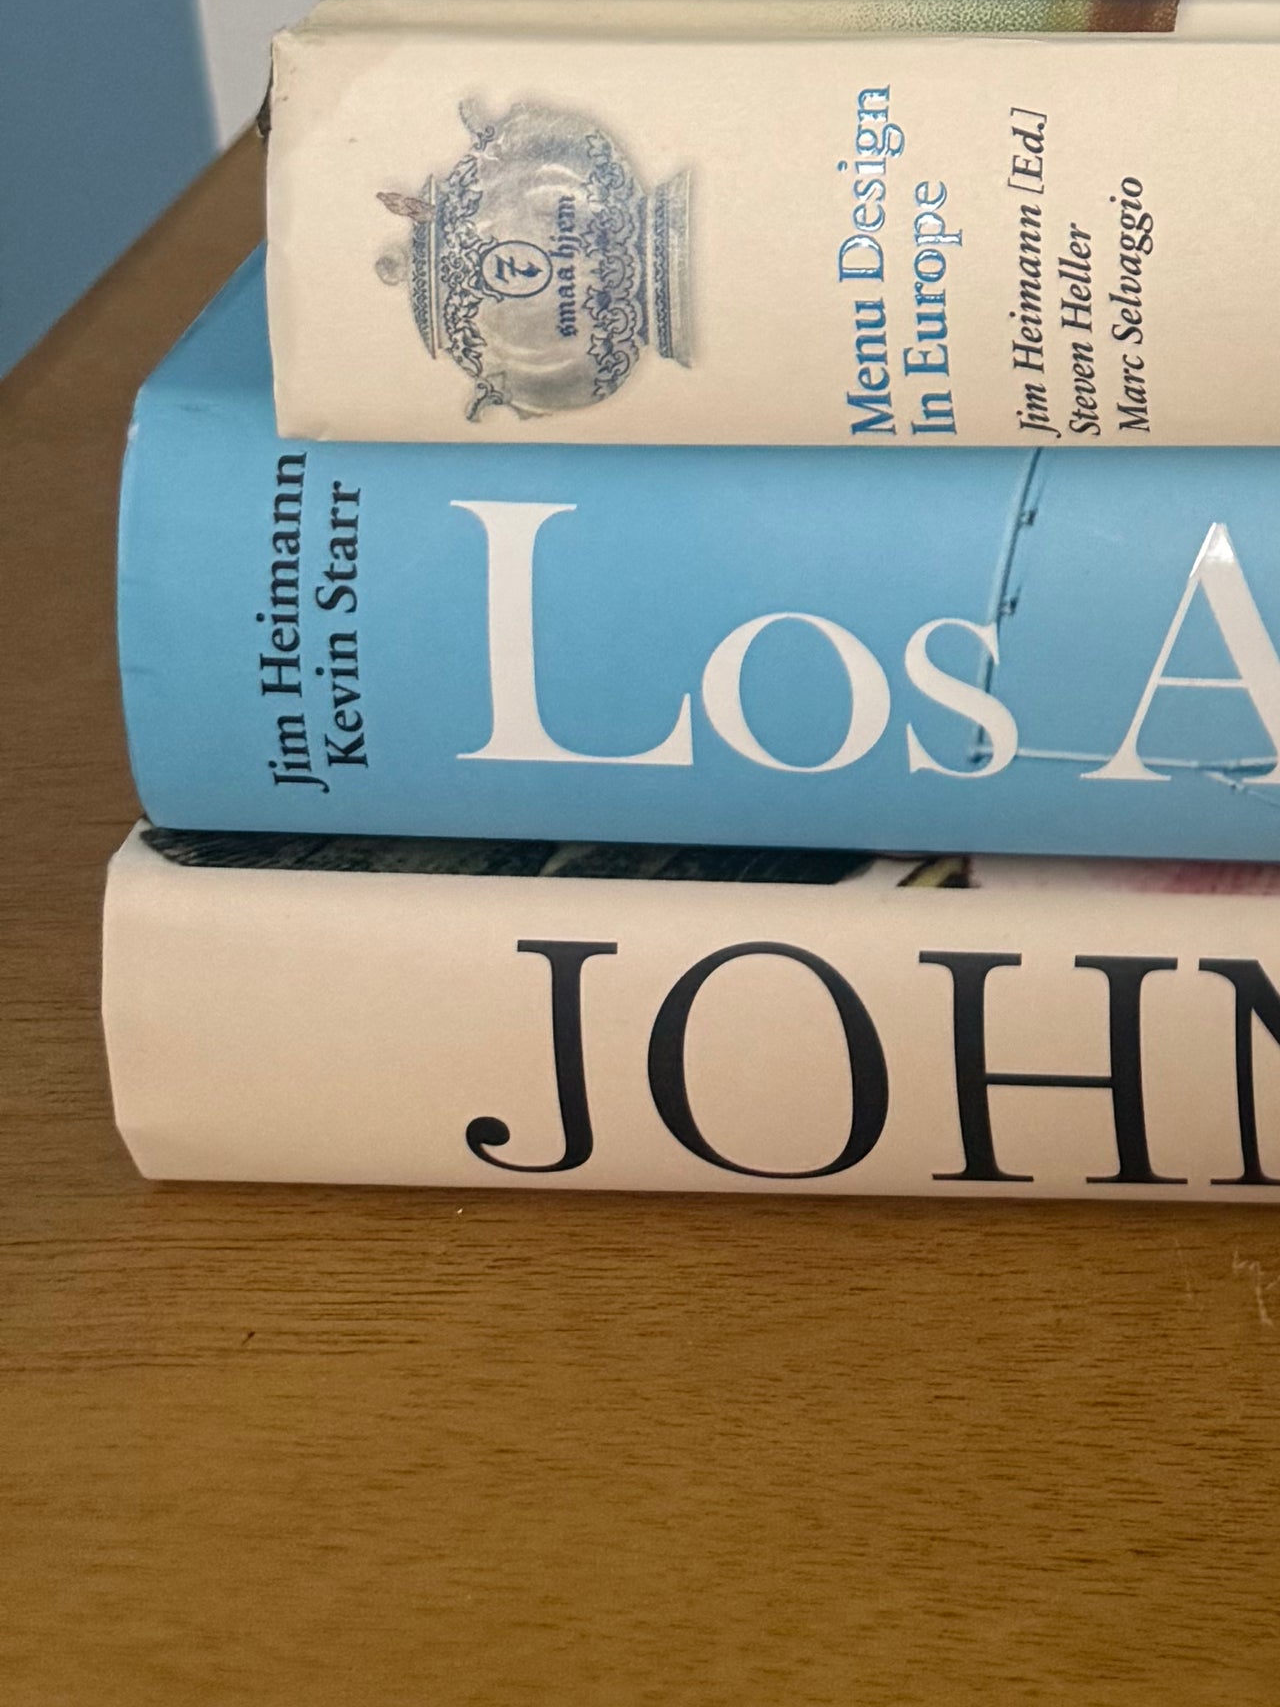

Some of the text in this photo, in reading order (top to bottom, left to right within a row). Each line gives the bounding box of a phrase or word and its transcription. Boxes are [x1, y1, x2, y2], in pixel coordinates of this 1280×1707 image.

[554, 268, 577, 337] smaa
[837, 85, 905, 436] Menu Design
[903, 180, 963, 435] In Europe
[1007, 107, 1061, 439] Jim Heimann [Ed.]
[1058, 222, 1101, 436] Steven Heller
[1108, 177, 1154, 433] Marc Selvaggio
[256, 451, 329, 793] Jim Heimann
[314, 480, 368, 768] Kevin Starr
[451, 500, 1018, 777] Los
